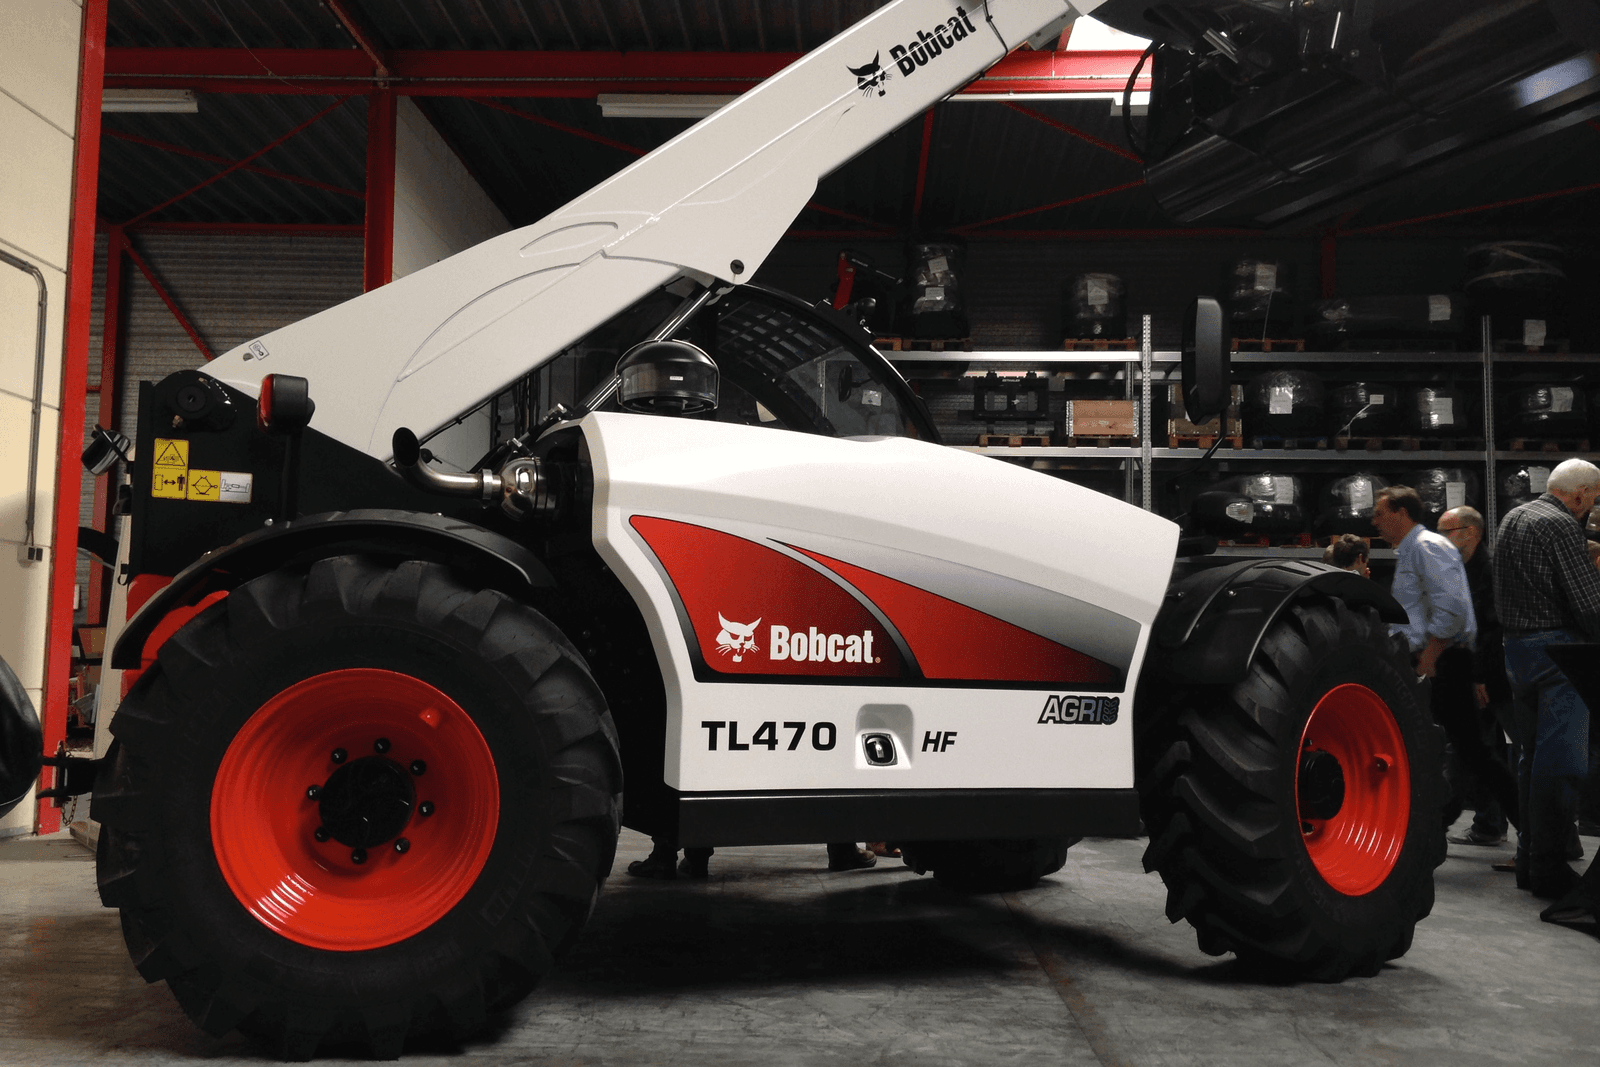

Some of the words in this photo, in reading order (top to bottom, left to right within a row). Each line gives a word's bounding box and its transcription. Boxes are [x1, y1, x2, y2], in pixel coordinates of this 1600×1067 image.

[889, 6, 976, 77] Bobcat
[770, 625, 874, 663] Bobcat
[1038, 695, 1104, 724] AGRI
[701, 721, 837, 751] TL470
[921, 731, 958, 752] HF
